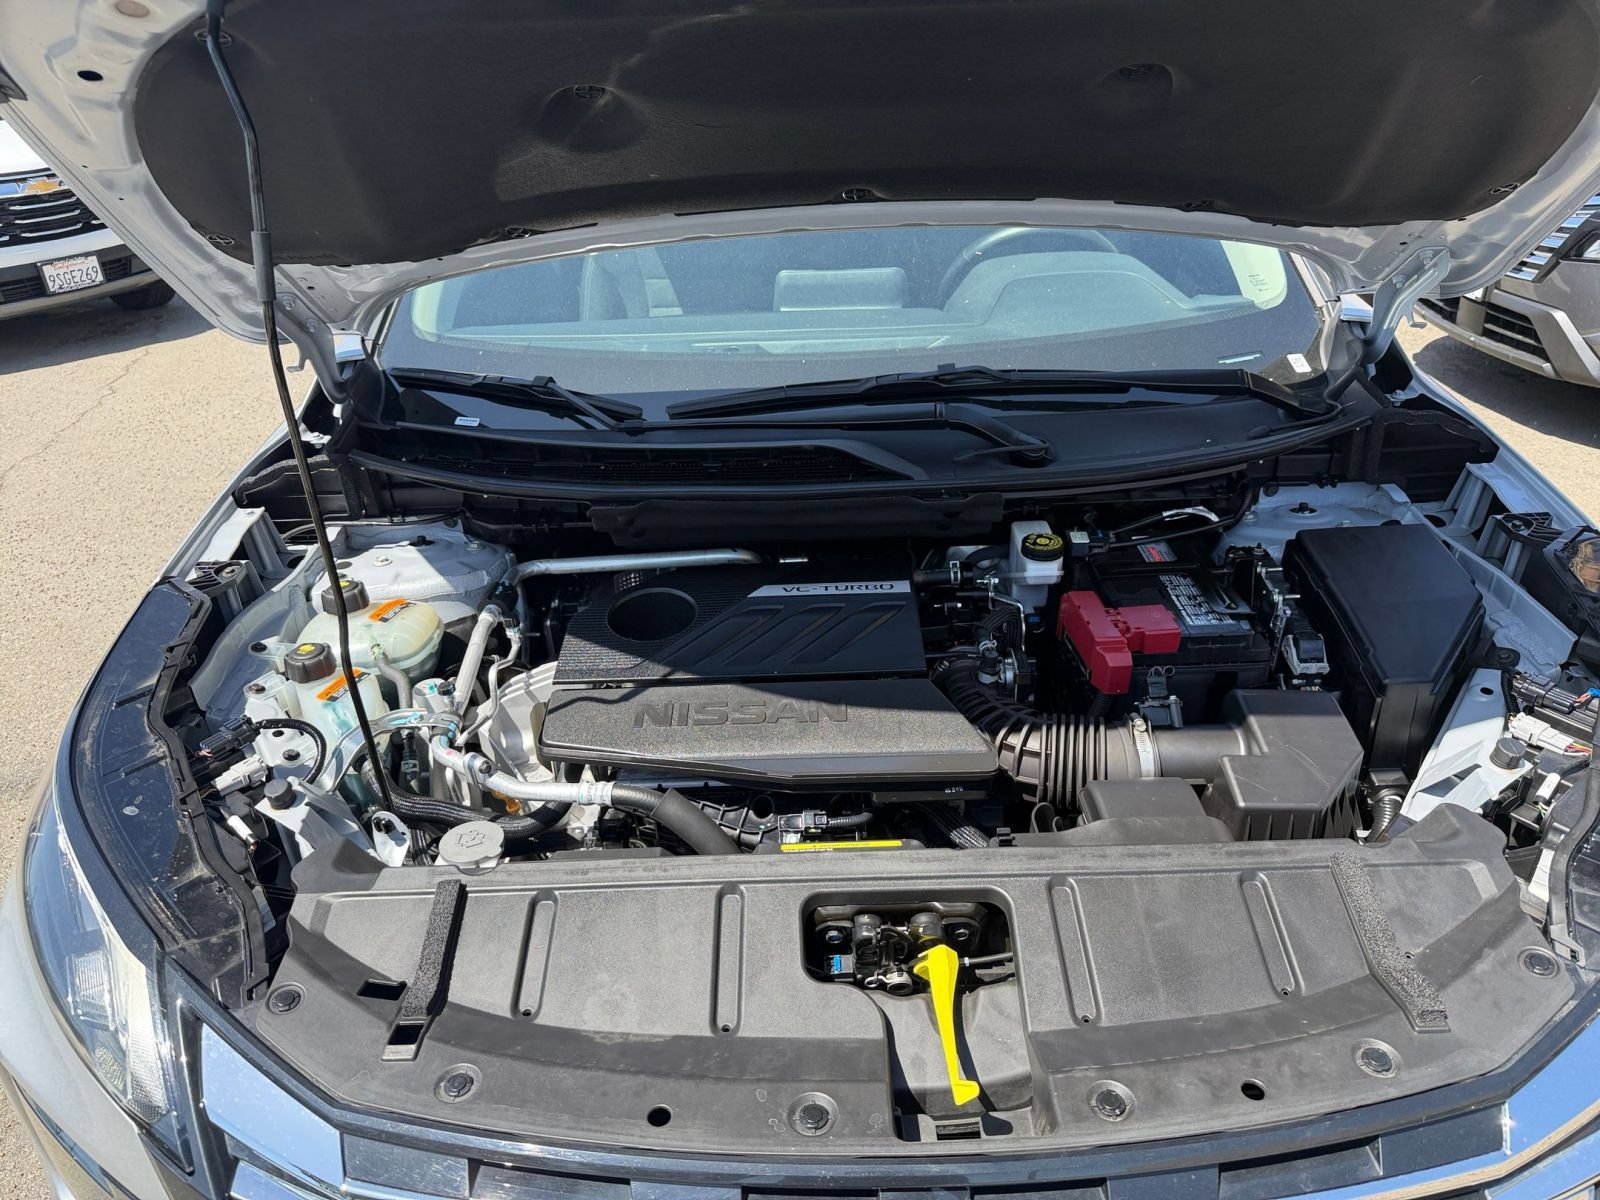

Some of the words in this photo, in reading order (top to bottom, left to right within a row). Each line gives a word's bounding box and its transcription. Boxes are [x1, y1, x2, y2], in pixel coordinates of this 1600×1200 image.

[48, 265, 99, 289] 9SGE269
[782, 583, 894, 593] VC-TURBO
[633, 699, 849, 729] NISSAN
